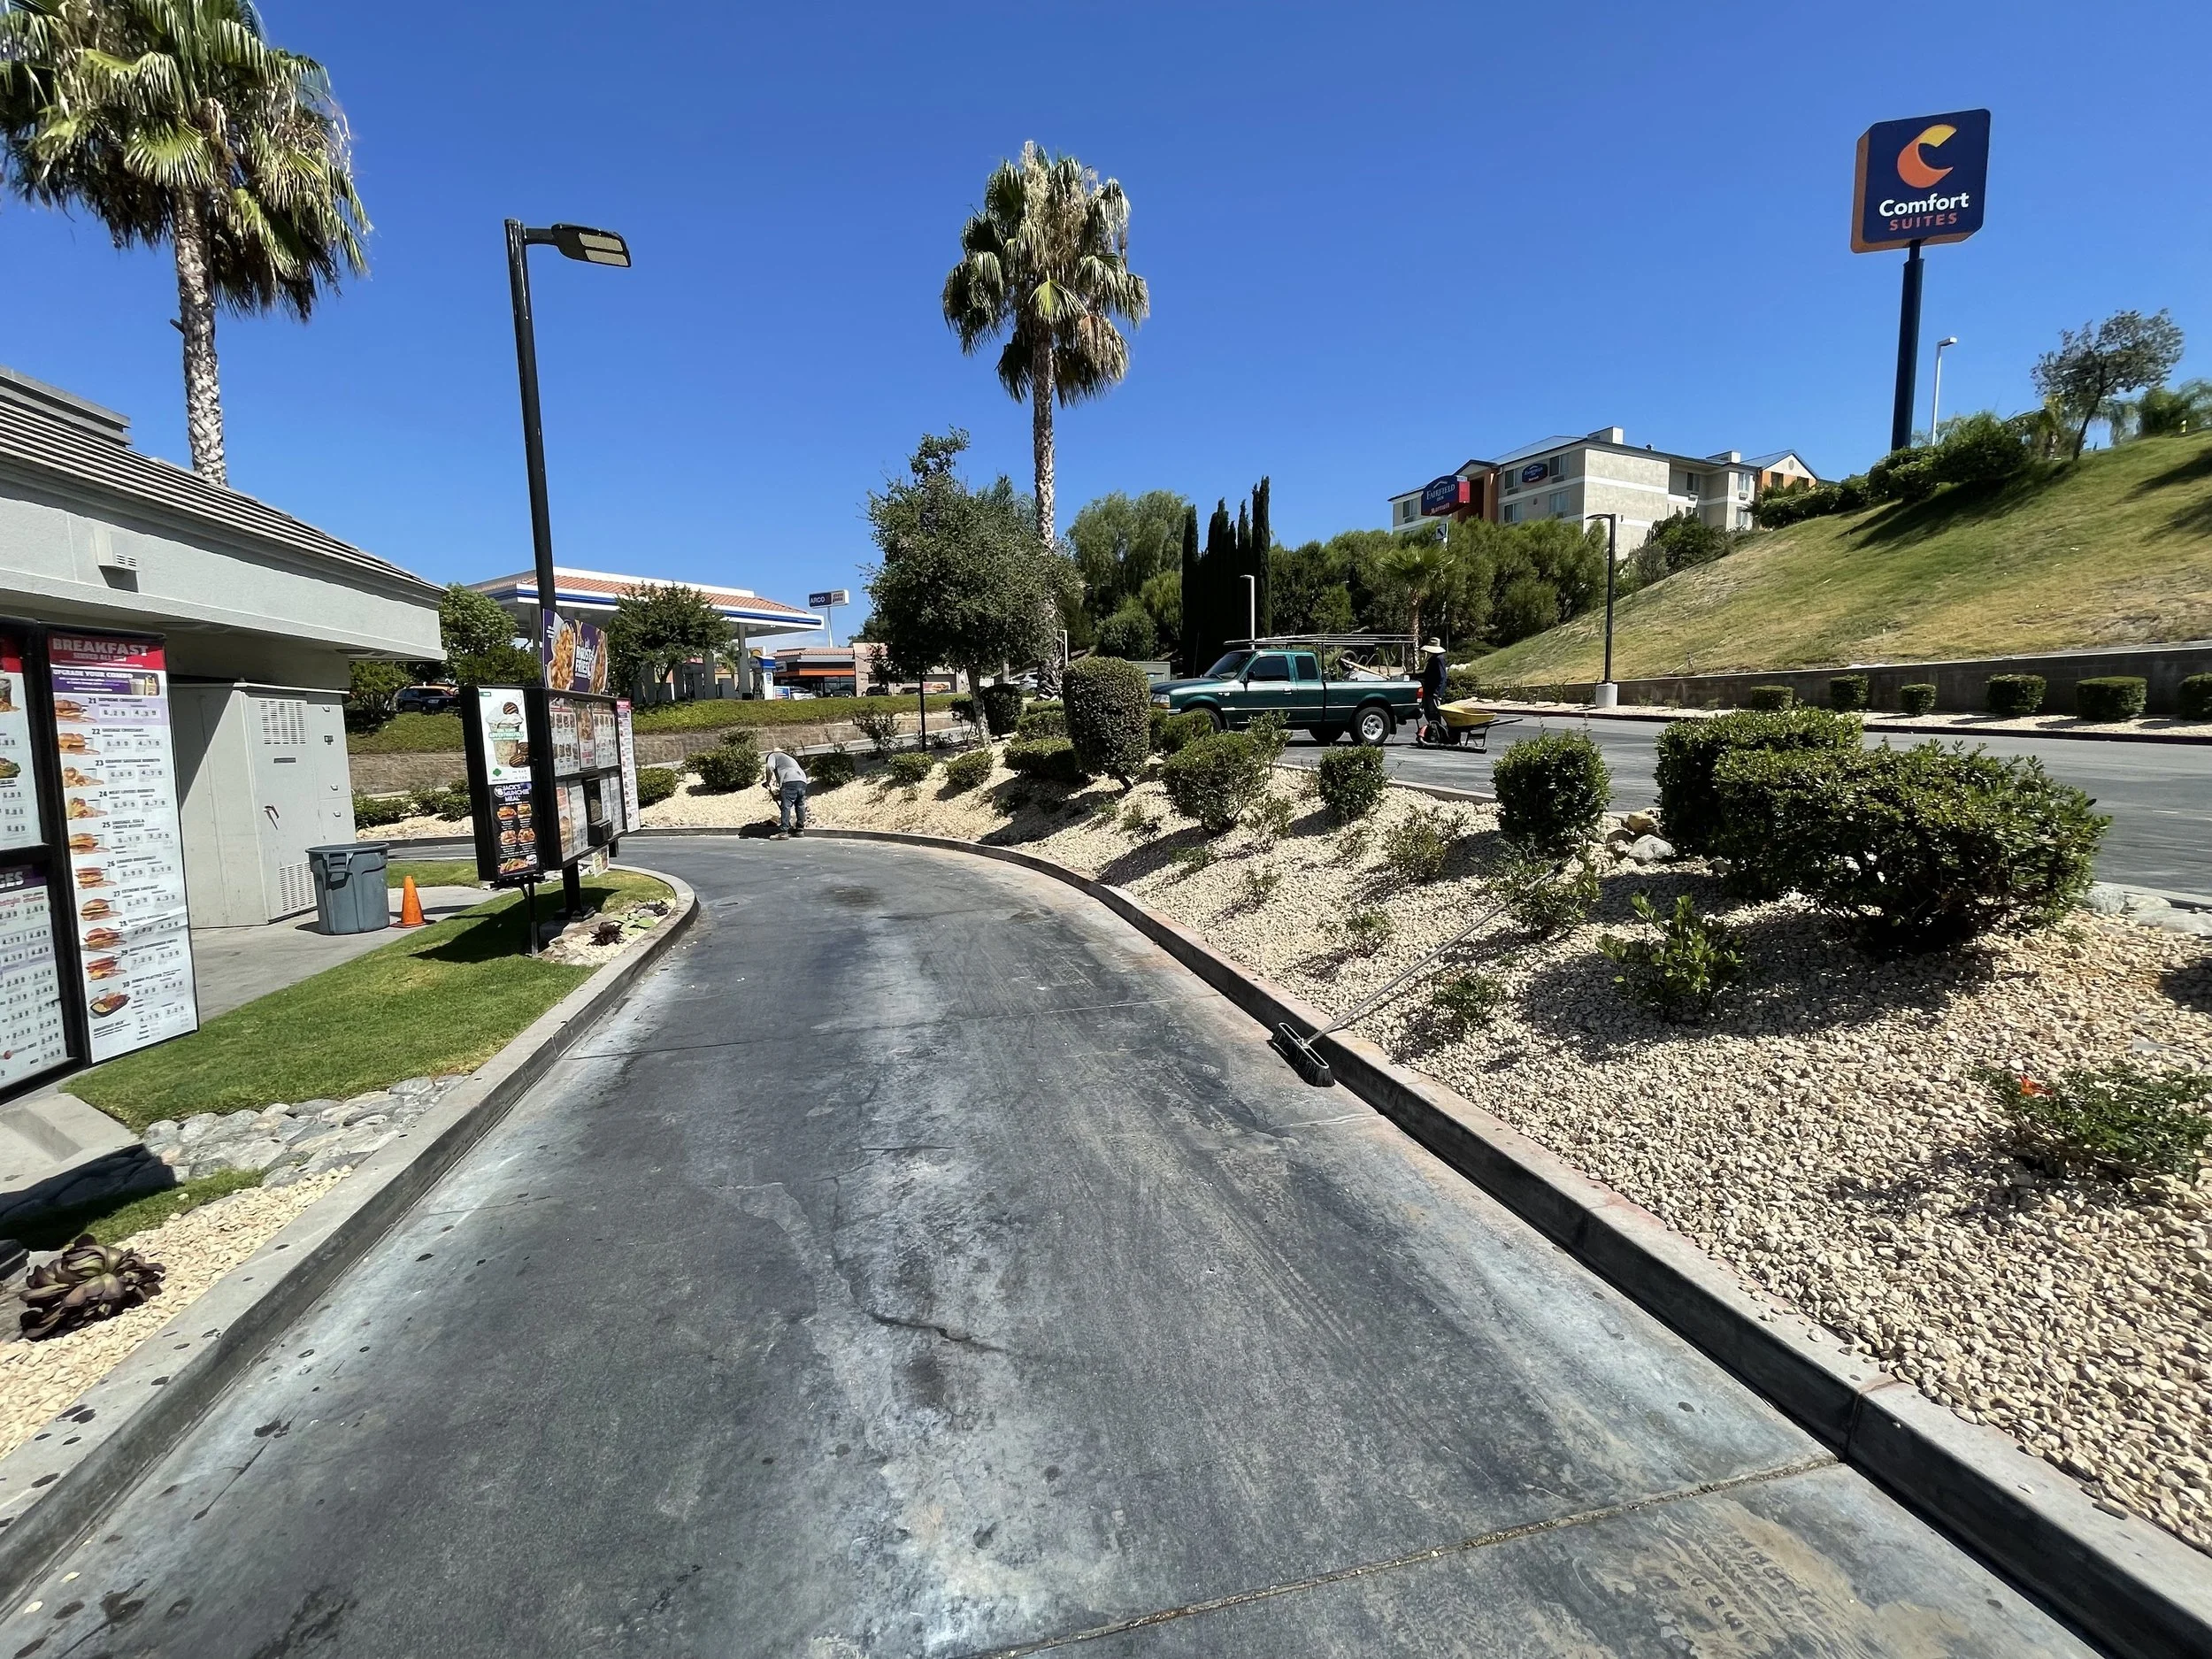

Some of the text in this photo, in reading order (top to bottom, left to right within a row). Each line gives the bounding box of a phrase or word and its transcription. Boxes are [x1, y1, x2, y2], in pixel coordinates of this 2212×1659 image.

[1879, 192, 1970, 217] Comfort
[1889, 212, 1958, 231] SUITES
[1426, 483, 1455, 500] FAIRFIELD
[53, 638, 149, 657] BREAKFAST
